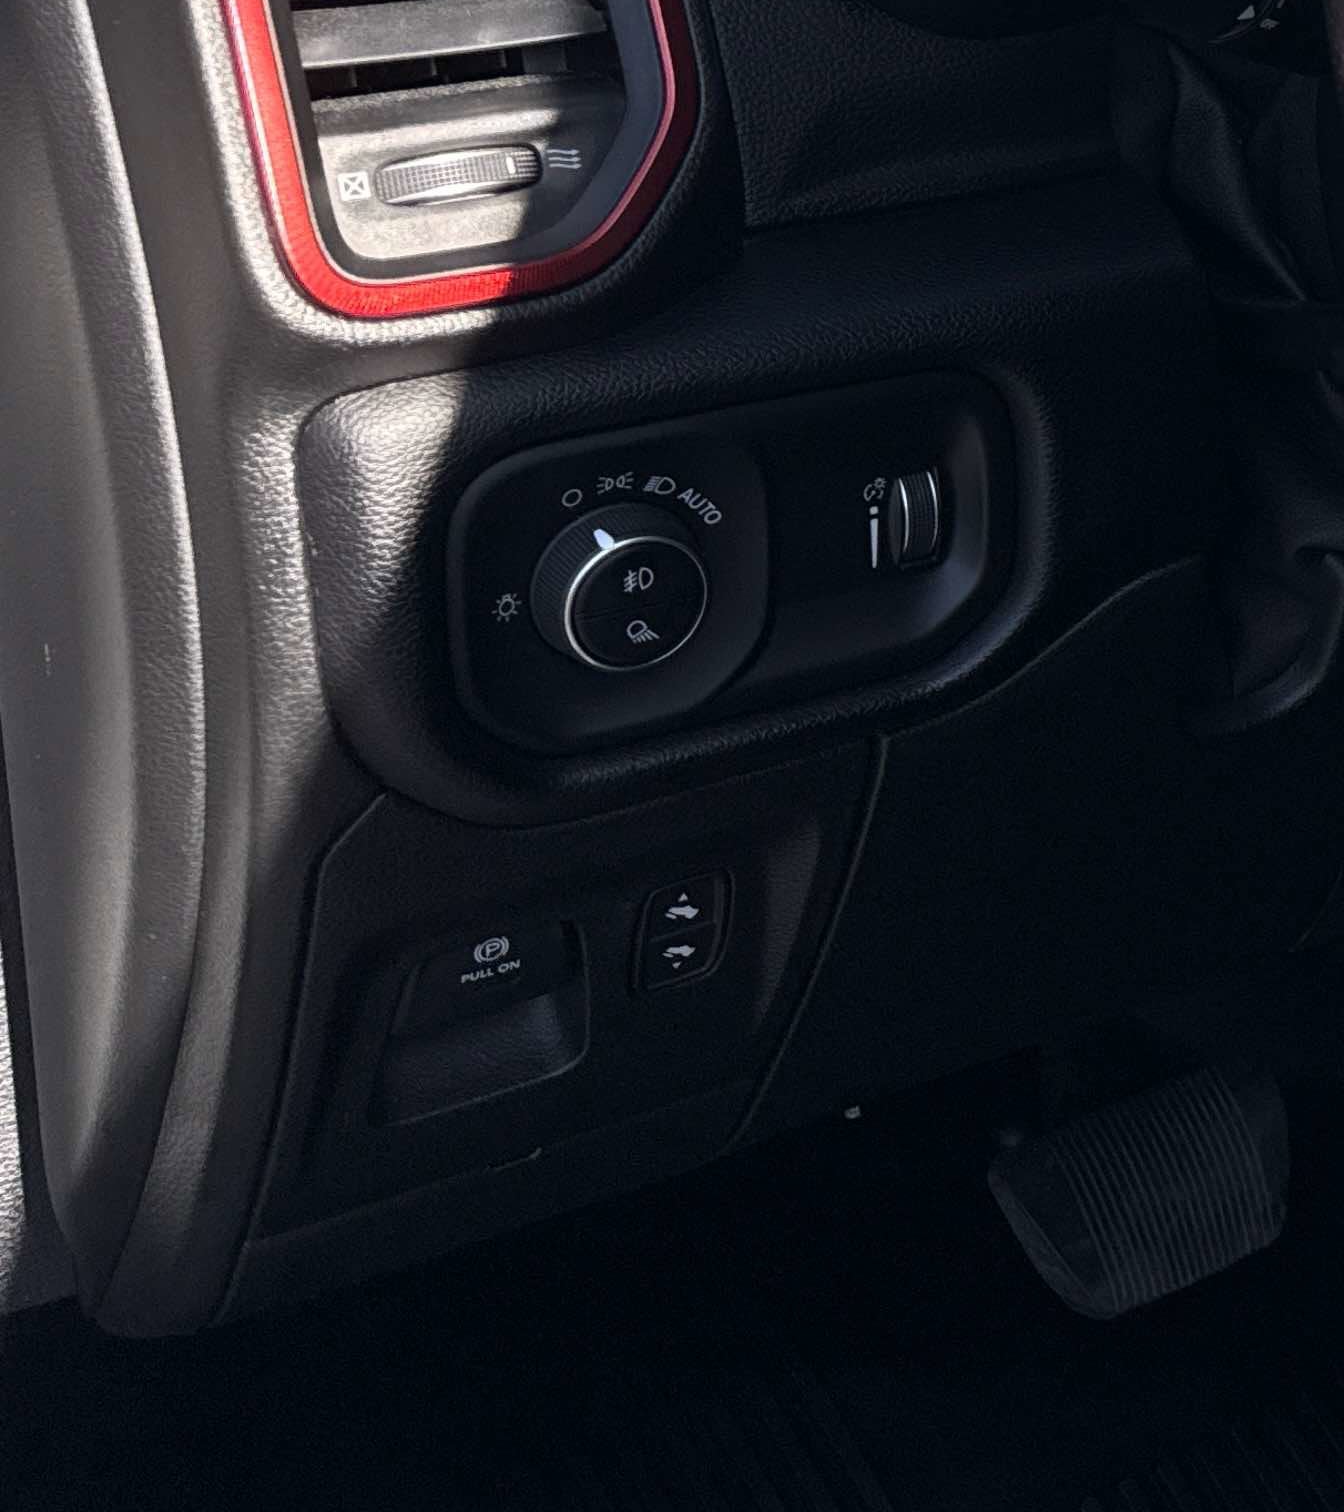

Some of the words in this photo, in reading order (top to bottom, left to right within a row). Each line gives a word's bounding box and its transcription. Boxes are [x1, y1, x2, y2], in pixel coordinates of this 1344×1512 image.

[676, 487, 722, 526] AUTO
[461, 967, 495, 984] PULL
[498, 958, 520, 974] ON
